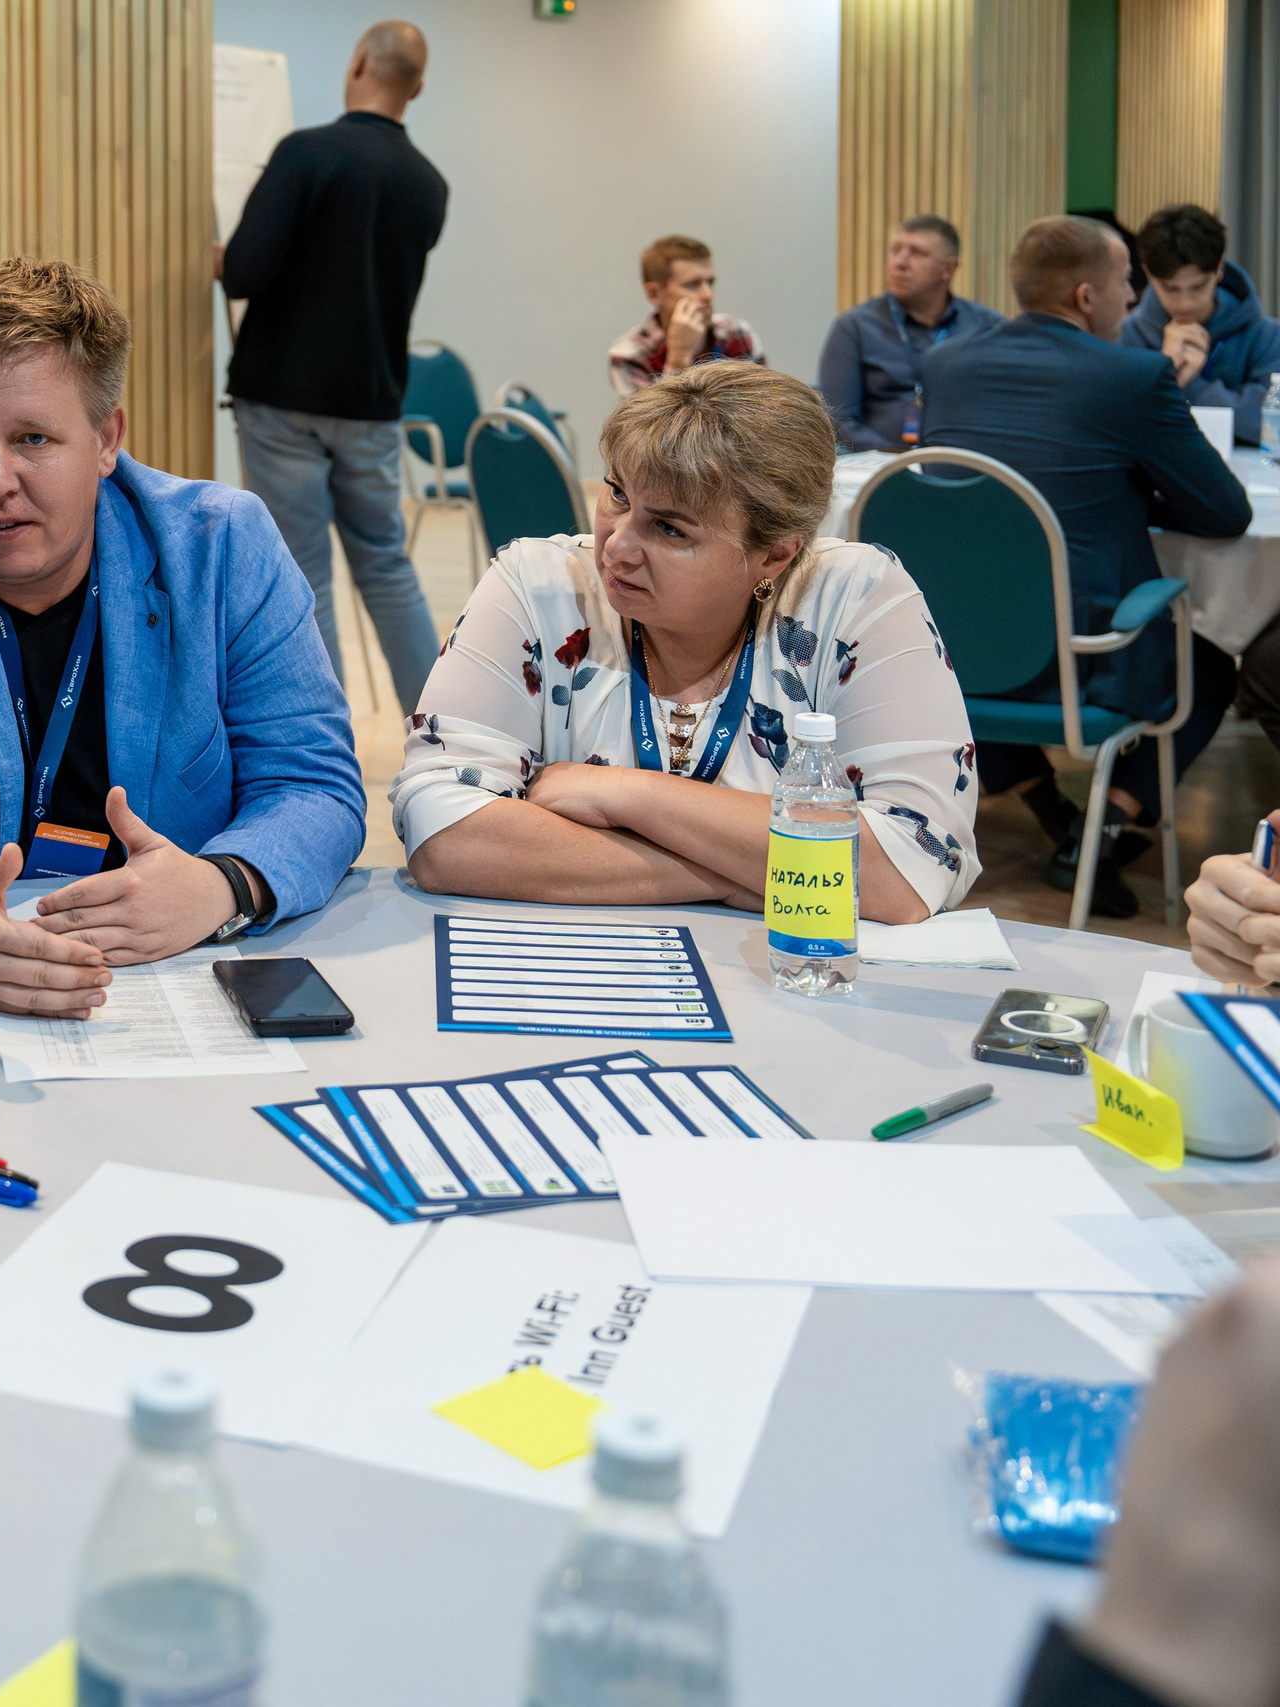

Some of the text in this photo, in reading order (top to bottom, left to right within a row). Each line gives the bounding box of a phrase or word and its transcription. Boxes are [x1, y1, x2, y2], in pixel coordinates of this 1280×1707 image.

[770, 867, 844, 888] НАТАЛЬЯ
[773, 895, 831, 916] Волга
[82, 1233, 284, 1333] 8
[565, 1284, 651, 1385] Inn Guest
